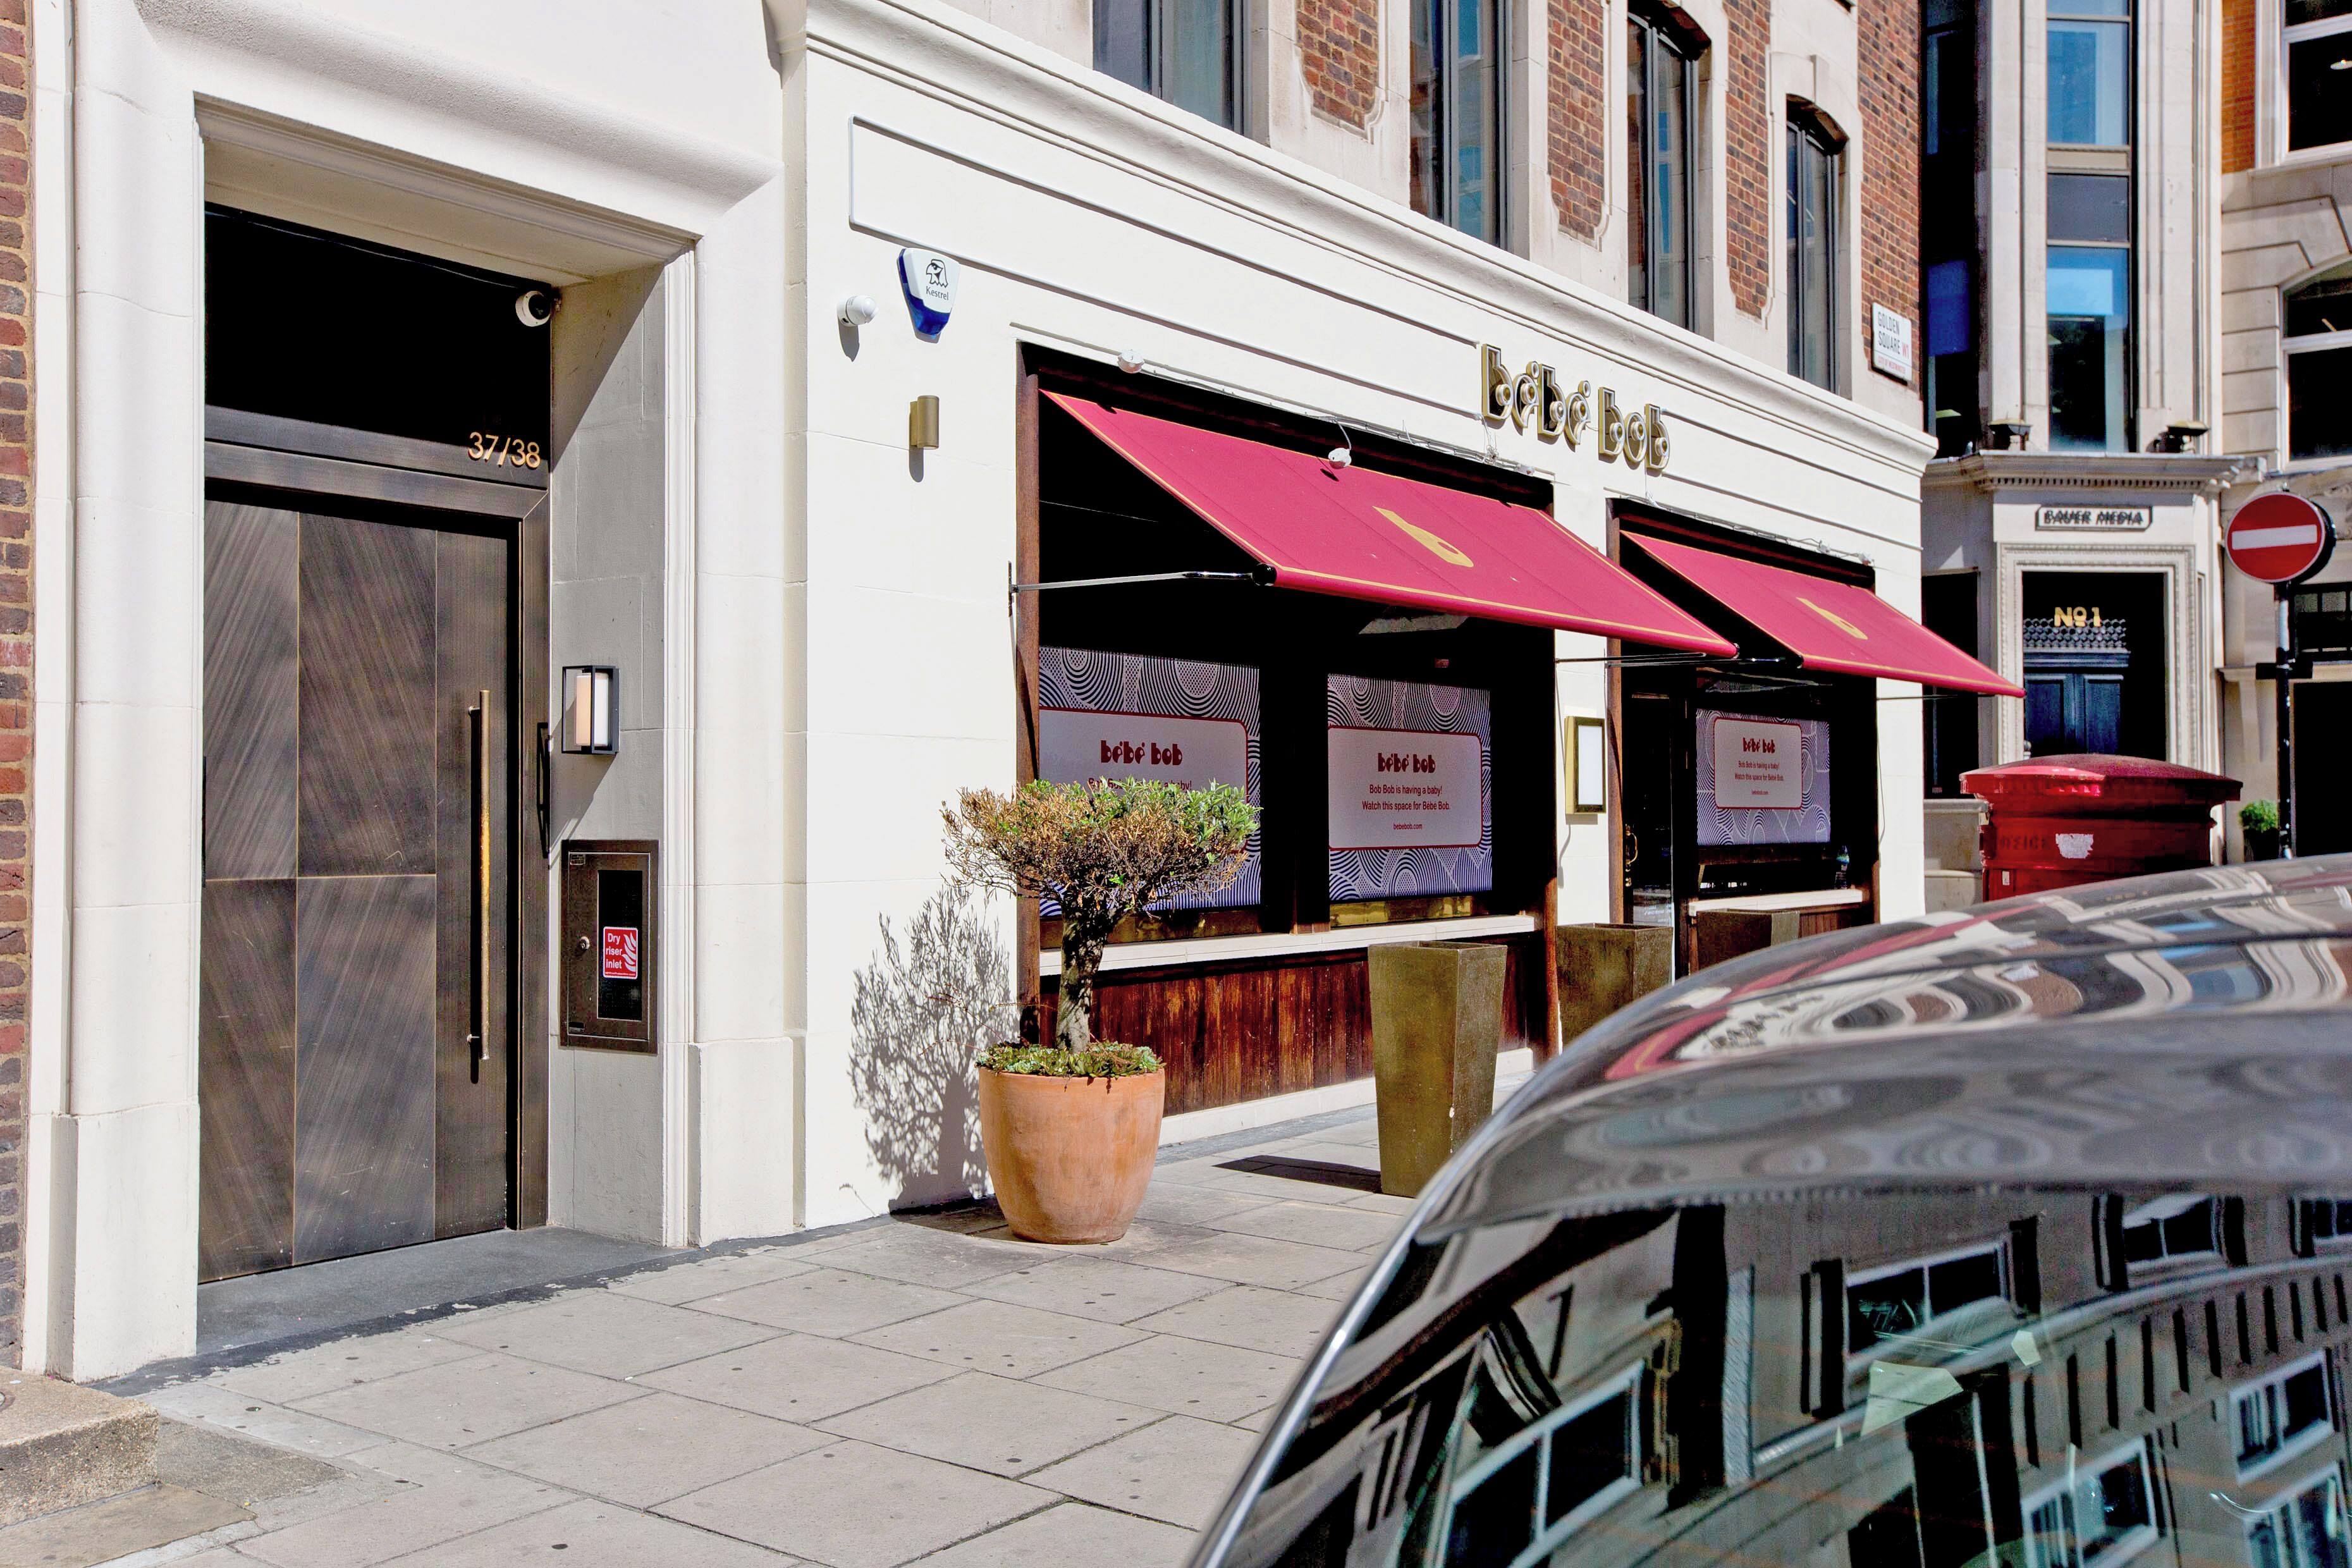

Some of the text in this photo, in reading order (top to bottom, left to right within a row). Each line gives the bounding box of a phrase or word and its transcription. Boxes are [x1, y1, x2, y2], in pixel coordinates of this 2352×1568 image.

[926, 285, 949, 300] Kestrel
[1878, 312, 1900, 336] GOLDEN
[1878, 331, 1909, 359] SQUARE W1
[1598, 386, 1670, 470] bob
[468, 432, 541, 469] 37/38
[2044, 510, 2143, 525] BAUER MEDIA
[1762, 738, 1775, 754] bob
[1151, 742, 1183, 766] bob
[1412, 754, 1436, 773] bob
[1369, 784, 1381, 793] Bob
[1383, 784, 1395, 793] Bob
[1396, 785, 1401, 793] is
[1402, 785, 1421, 797] having
[1427, 785, 1443, 797] baby!
[1362, 800, 1381, 810] Watch
[1382, 800, 1393, 810] this
[1394, 802, 1412, 812] space
[1413, 800, 1421, 810] for
[1438, 801, 1451, 810] Bob.
[608, 933, 621, 945] Dry
[606, 946, 623, 955] riser
[606, 959, 622, 969] inlet
